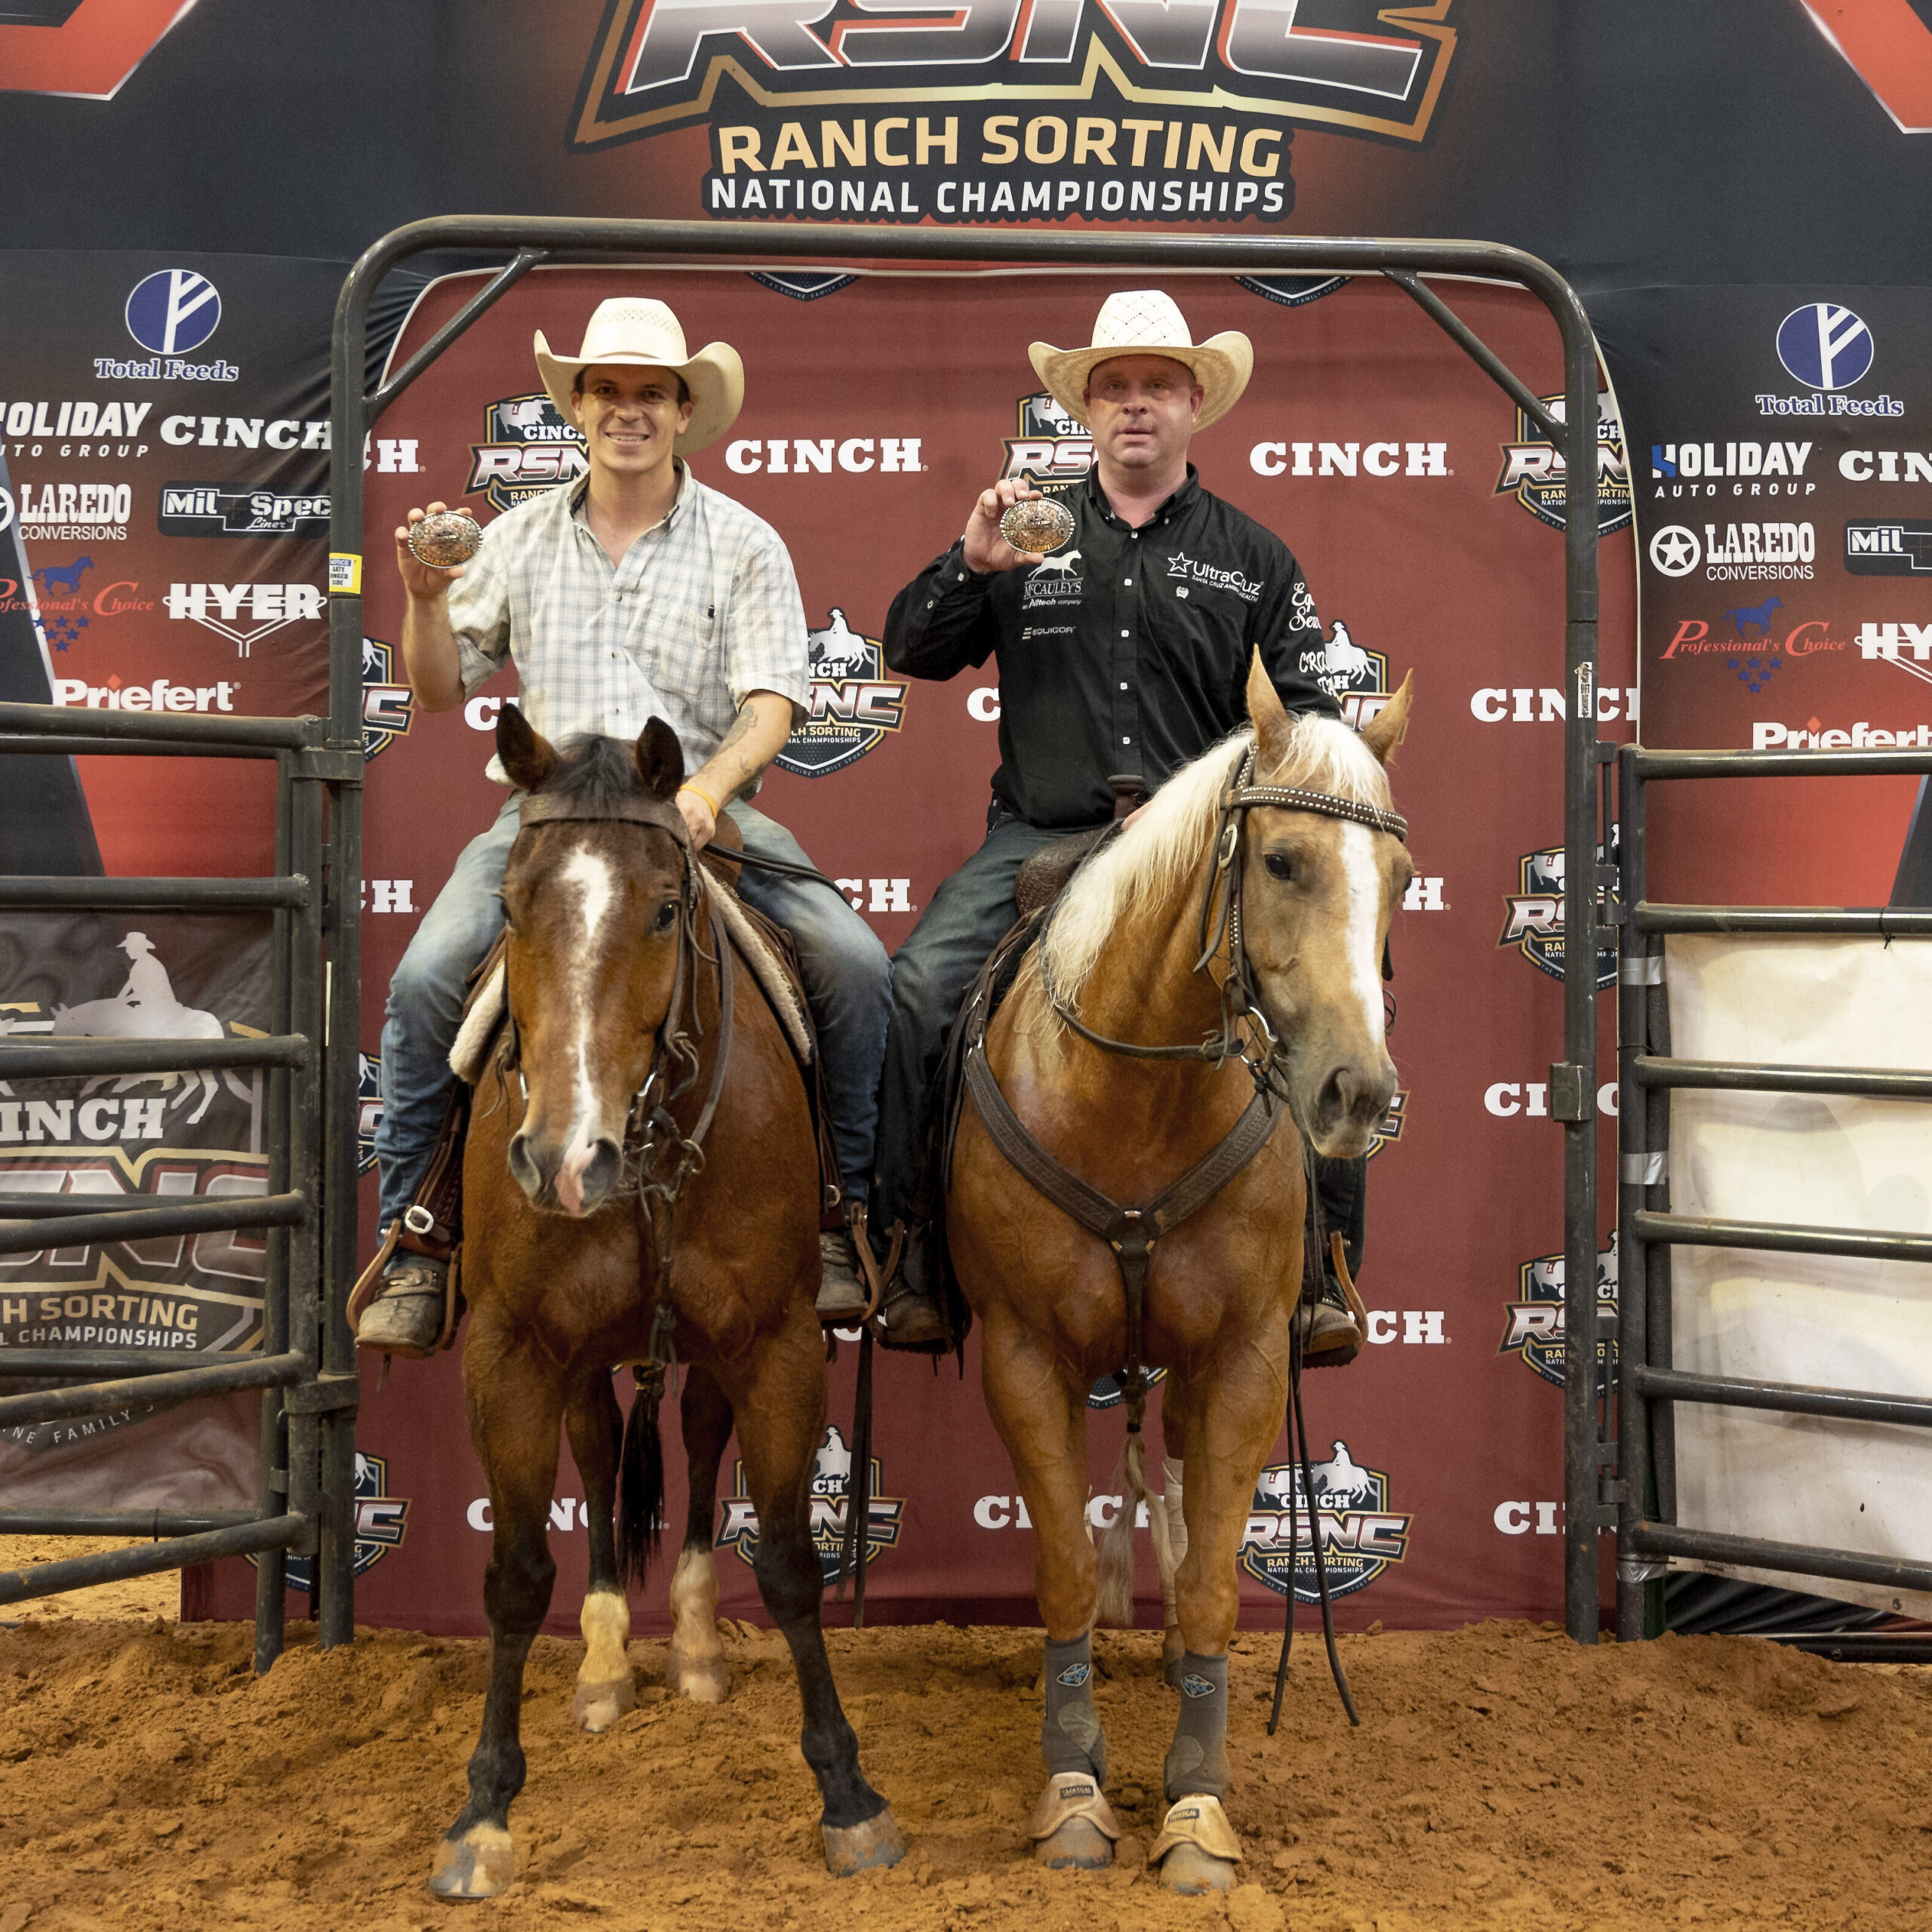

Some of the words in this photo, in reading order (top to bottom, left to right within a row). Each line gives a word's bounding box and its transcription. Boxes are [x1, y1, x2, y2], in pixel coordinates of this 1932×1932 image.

[718, 116, 958, 174] RANCH
[981, 115, 1283, 177] SORTING
[712, 178, 919, 213] NATIONAL
[937, 180, 1284, 213] CHAMPIONSHIPS
[1296, 292, 1321, 304] FAMILY
[94, 357, 161, 379] Total
[163, 359, 239, 382] Feeds
[0, 401, 152, 437] OLIDAY
[1755, 394, 1825, 415] Total
[1827, 395, 1904, 417] Feeds
[524, 426, 586, 440] CINC
[60, 444, 149, 457] GROUP
[724, 438, 922, 475] CINCH
[1250, 441, 1447, 477] CINCH
[1652, 441, 1813, 478] HOLIDAY
[472, 449, 590, 488] RSN
[20, 483, 132, 525] LAREDO
[166, 492, 217, 514] Mil
[1655, 483, 1717, 498] AUTO
[1733, 483, 1816, 497] GROUP
[18, 525, 128, 540] CONVERSIONS
[248, 516, 287, 529] Liner
[1705, 521, 1815, 564] LAREDO
[1851, 529, 1903, 552] Mil
[1209, 580, 1225, 589] CRUZ
[1706, 565, 1814, 581] CONVERSIONS
[94, 581, 154, 616] Choice
[168, 583, 321, 620] HYER
[1659, 620, 1780, 660] Professional's
[1785, 621, 1846, 657] Choice
[52, 674, 234, 712] Priefert
[809, 727, 861, 737] SORTING
[816, 762, 842, 776] FAMILY
[844, 749, 866, 764] SPORT
[0, 1098, 167, 1141] INCH
[40, 1294, 199, 1331] SORTING
[18, 1326, 198, 1349] CHAMPIONSHIPS
[54, 1409, 131, 1443] FAMILY
